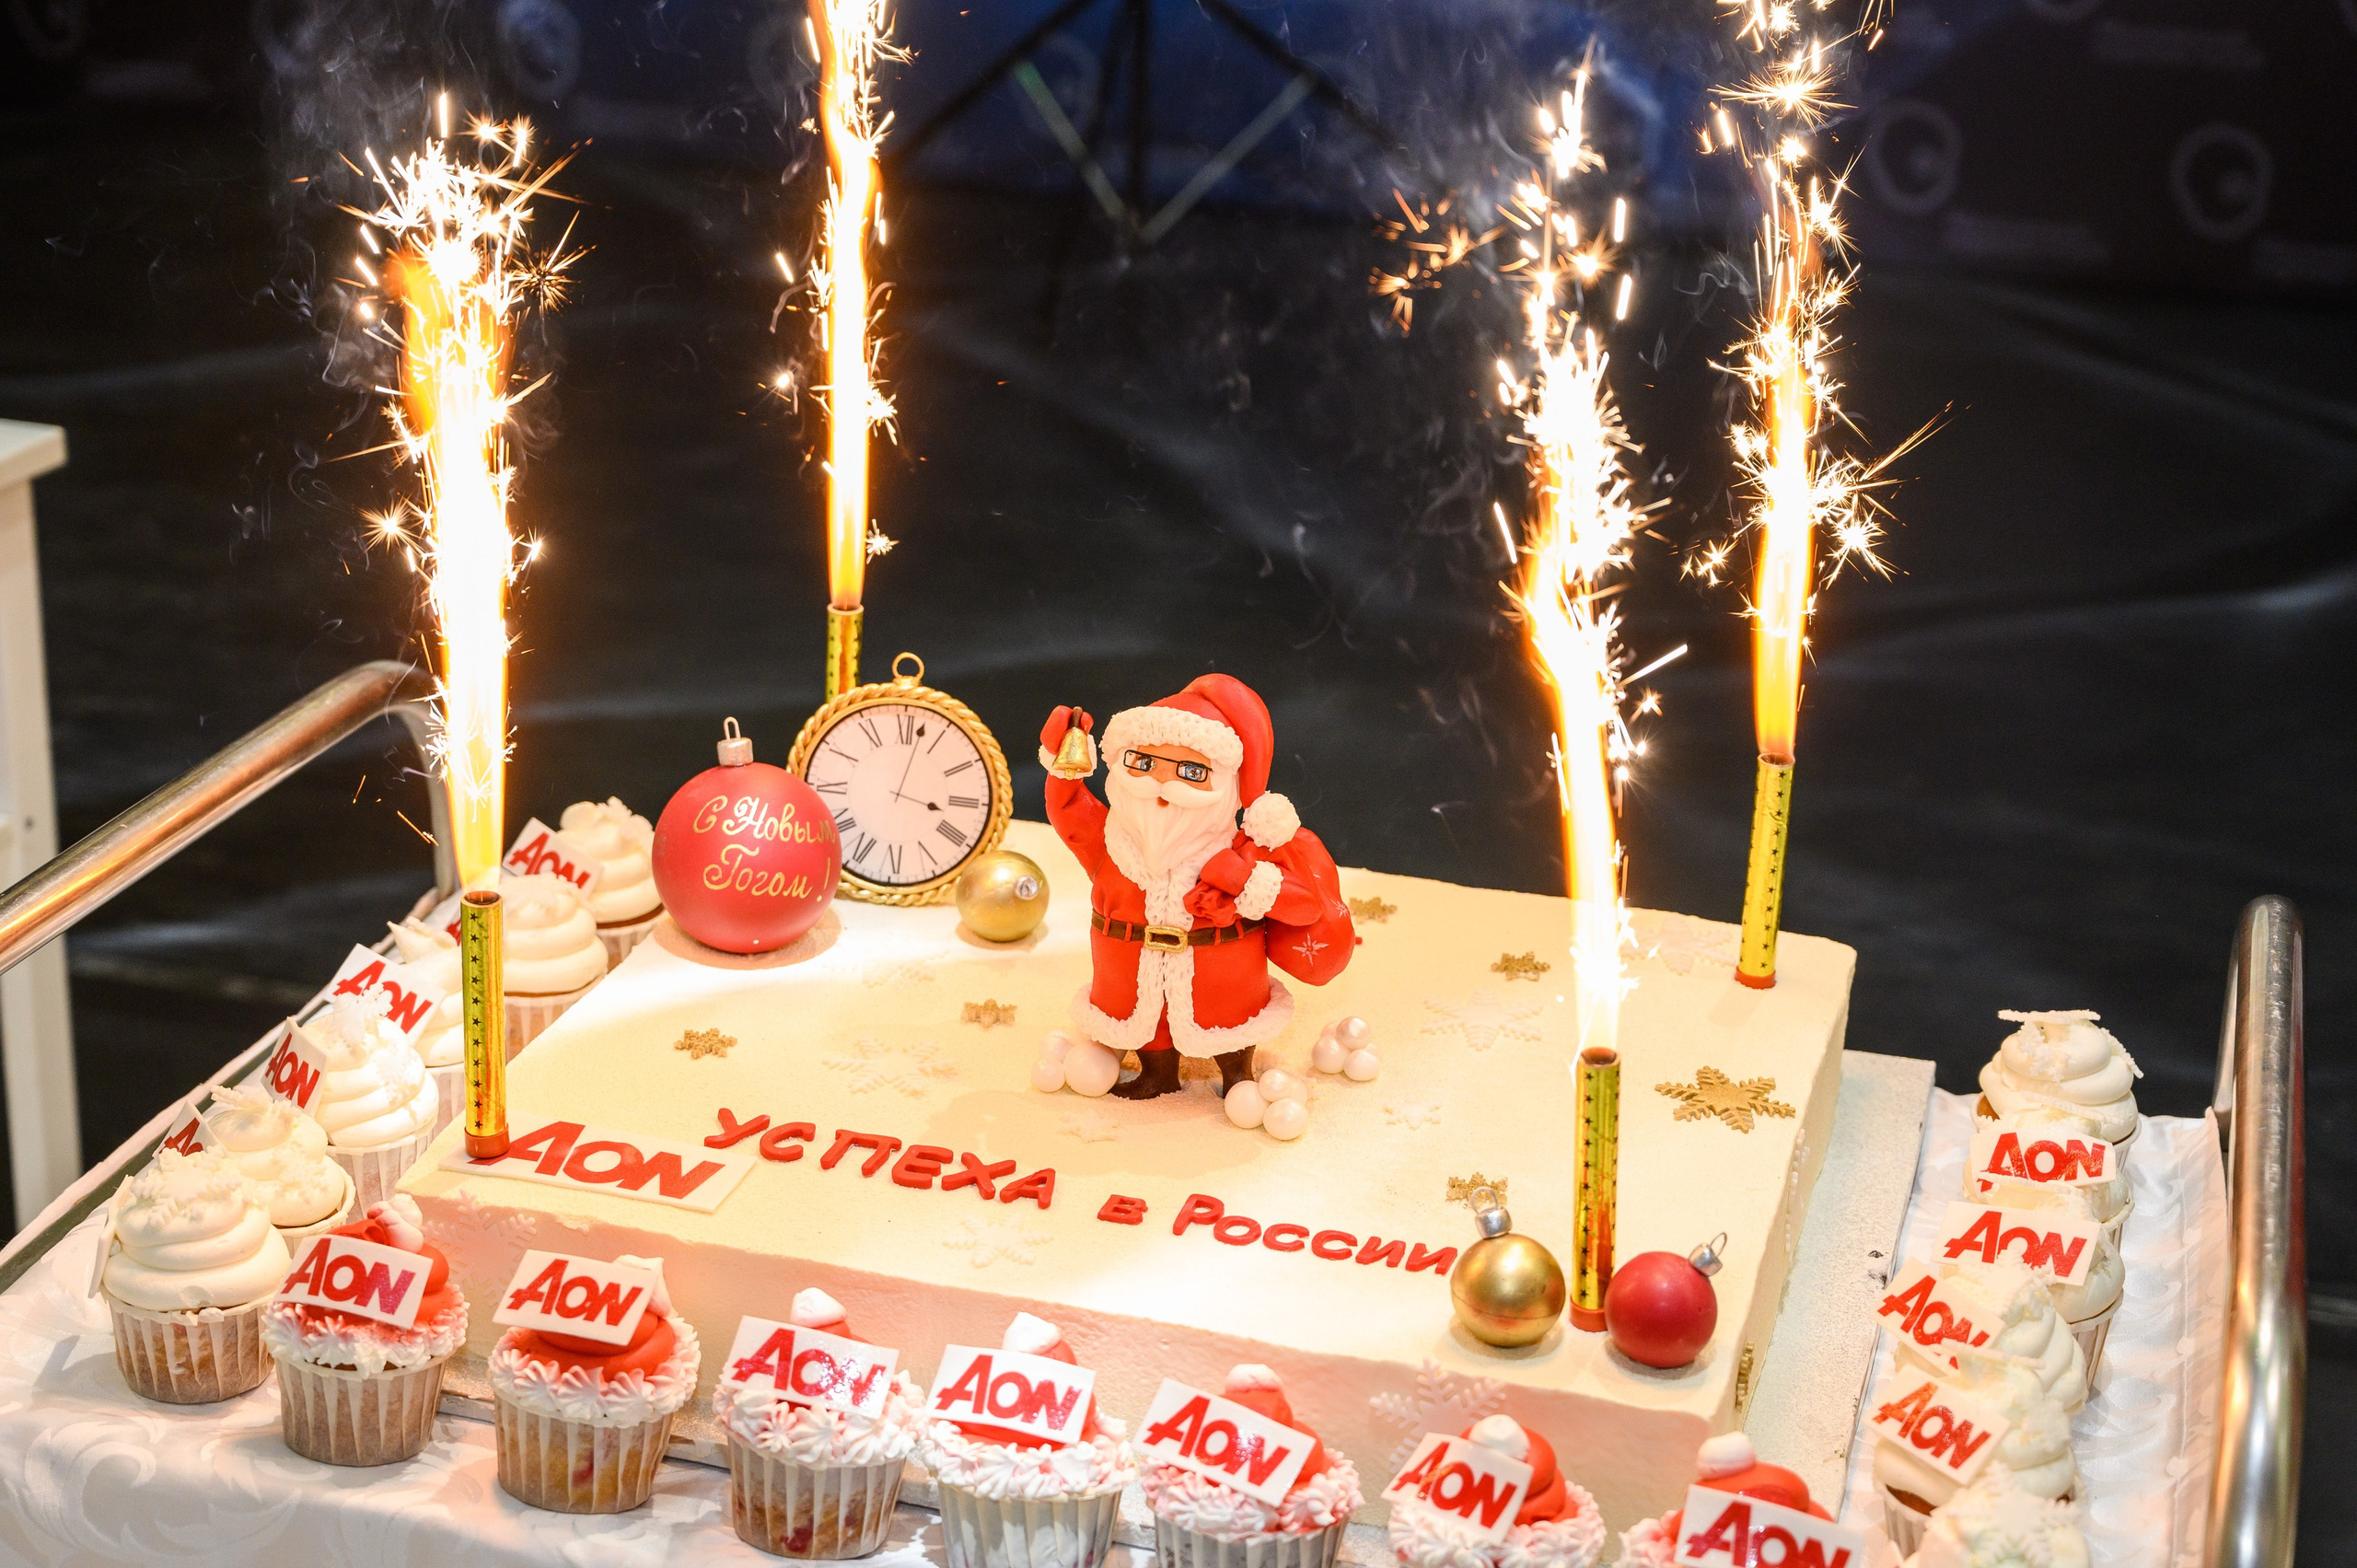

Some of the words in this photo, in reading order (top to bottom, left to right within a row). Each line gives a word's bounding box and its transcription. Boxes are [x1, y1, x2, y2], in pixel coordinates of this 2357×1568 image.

[722, 796, 836, 843] Новым
[704, 1107, 1057, 1210] УСПЕХА
[1172, 1193, 1458, 1276] России
